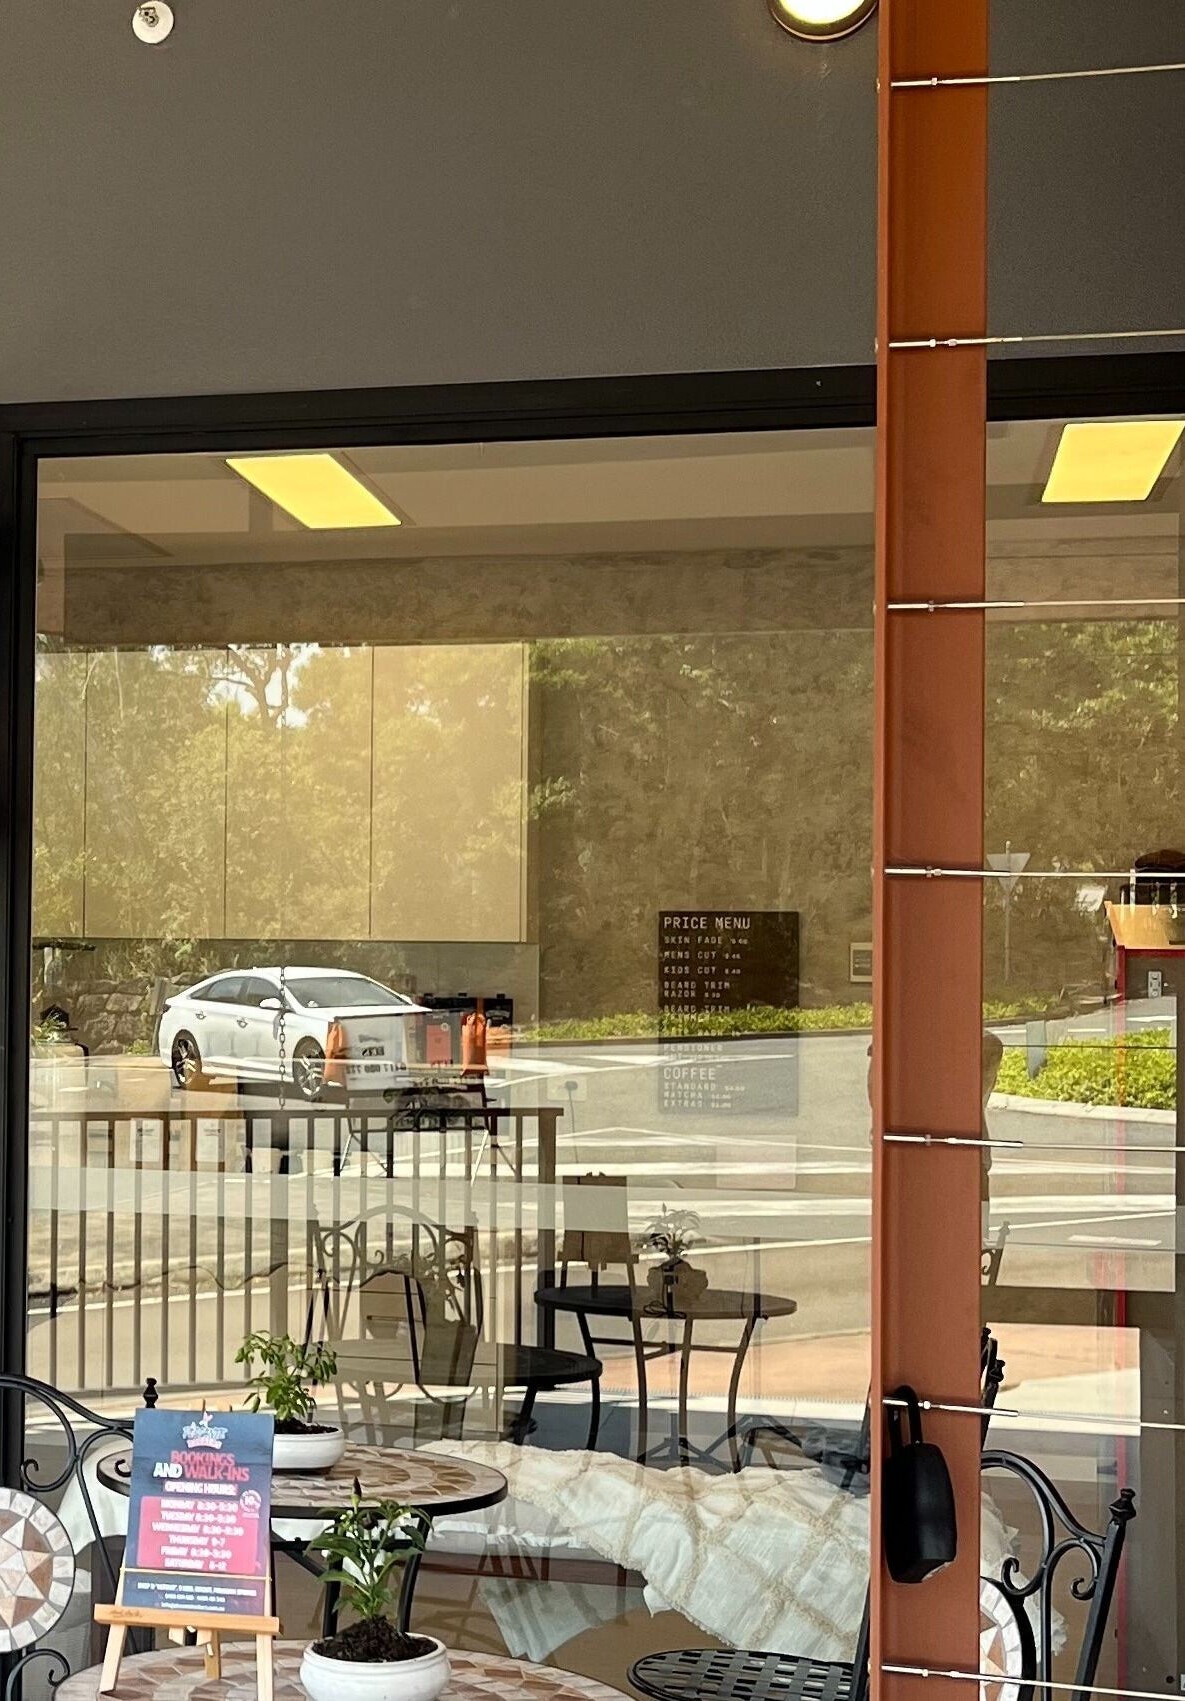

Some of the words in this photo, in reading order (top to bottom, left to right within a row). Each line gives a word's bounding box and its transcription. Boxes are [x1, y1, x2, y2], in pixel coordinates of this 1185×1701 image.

[664, 916, 708, 929] PRICE
[715, 916, 751, 930] MENU
[664, 935, 691, 945] SKIN
[697, 935, 723, 945] FADE
[664, 951, 690, 960] MENS
[697, 950, 716, 960] CUT
[664, 965, 690, 975] KIDS
[697, 965, 716, 975] CUT
[664, 980, 696, 990] BEARD
[704, 980, 731, 990] TRIM
[664, 990, 696, 998] RAZOR
[664, 1067, 716, 1080] COFFEE
[170, 1450, 235, 1467] BOOKINGS
[153, 1462, 183, 1479] AND
[185, 1464, 251, 1482] WALK-INS
[164, 1480, 203, 1493] OPENING
